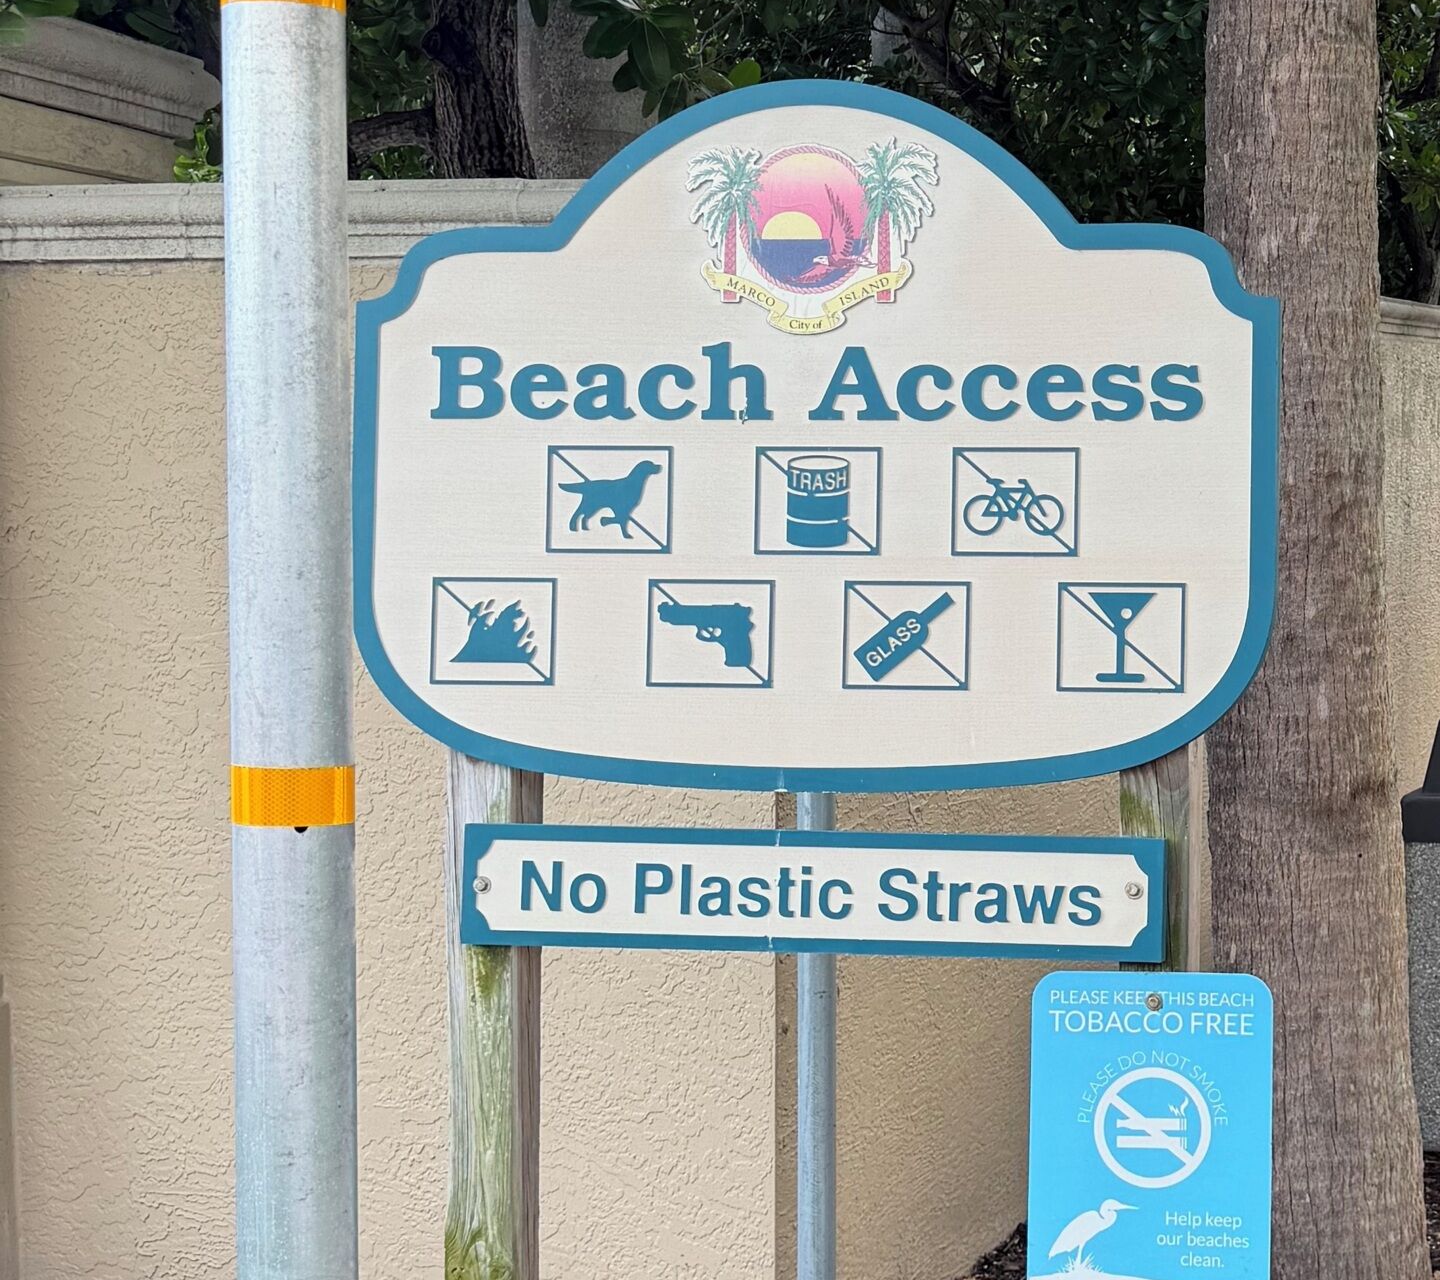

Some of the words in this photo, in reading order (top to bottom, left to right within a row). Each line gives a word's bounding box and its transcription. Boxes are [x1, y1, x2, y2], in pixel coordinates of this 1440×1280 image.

[727, 277, 776, 307] MARCO
[839, 276, 890, 307] ISLAND
[789, 319, 811, 330] City
[812, 319, 822, 329] of
[428, 341, 774, 421] Beach
[808, 346, 1203, 422] Access
[790, 469, 847, 491] TRASH
[866, 618, 921, 667] GLASS
[520, 860, 608, 915] No
[634, 862, 853, 920] Plastic
[878, 867, 1103, 928] Straws
[1050, 990, 1109, 1005] PLEASE
[1199, 992, 1255, 1008] BEACH
[1048, 1010, 1184, 1035] TOBACCO
[1190, 1012, 1255, 1036] FREE
[1077, 1063, 1118, 1124] PLEASE
[1117, 1051, 1147, 1071] DO
[1151, 1050, 1190, 1070] NOT
[1189, 1065, 1229, 1126] SMOKE
[1165, 1211, 1202, 1229] Help
[1205, 1211, 1242, 1231] keep
[1156, 1233, 1183, 1246] our
[1187, 1231, 1250, 1249] beaches
[1180, 1251, 1225, 1268] clean.
